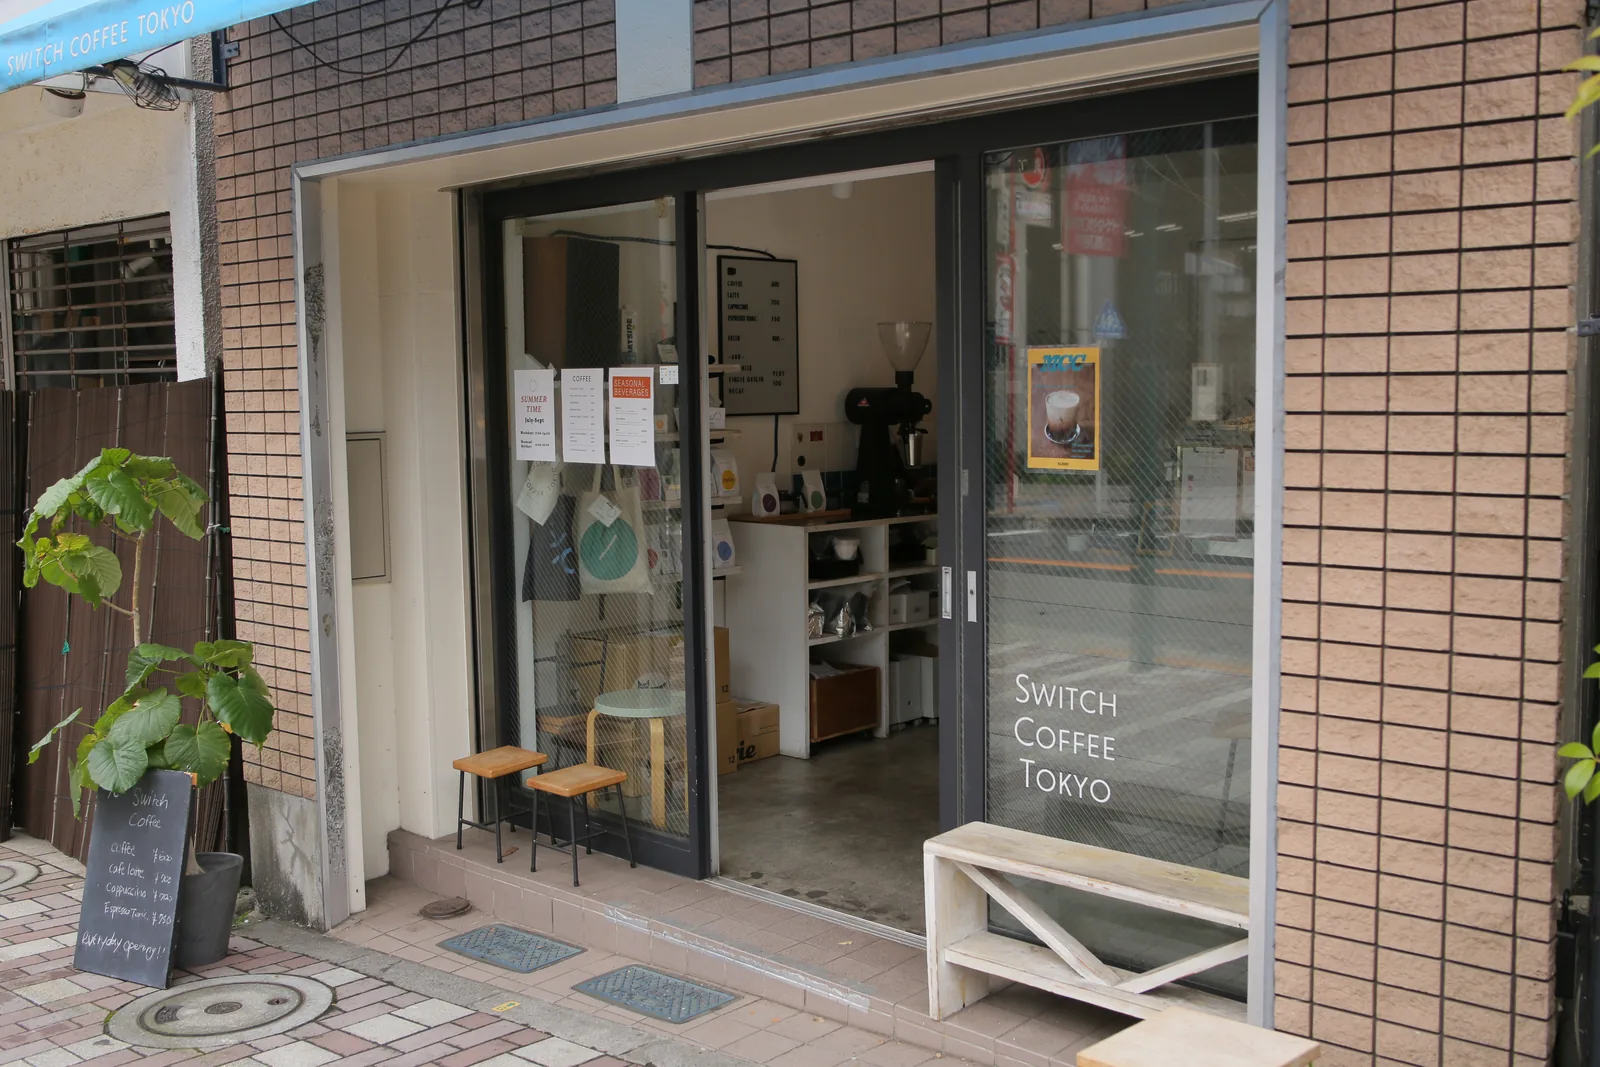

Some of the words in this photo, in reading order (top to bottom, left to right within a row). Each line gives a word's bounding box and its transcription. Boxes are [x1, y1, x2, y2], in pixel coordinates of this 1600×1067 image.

[7, 40, 63, 76] SWITCH
[70, 20, 128, 57] COFFEE
[138, 0, 194, 37] TOKYO
[572, 375, 591, 383] COFFEE
[613, 379, 646, 388] SEASONAL
[613, 388, 649, 398] BEVERAGES
[520, 395, 548, 404] SUMMER
[526, 405, 542, 413] TIME
[721, 685, 729, 693] 12
[1015, 673, 1117, 717] SWITCH
[1014, 716, 1116, 761] COFFEE
[728, 756, 735, 764] 12
[1019, 757, 1111, 803] TOKYO
[132, 787, 169, 809] Switch
[128, 812, 162, 829] Coffee
